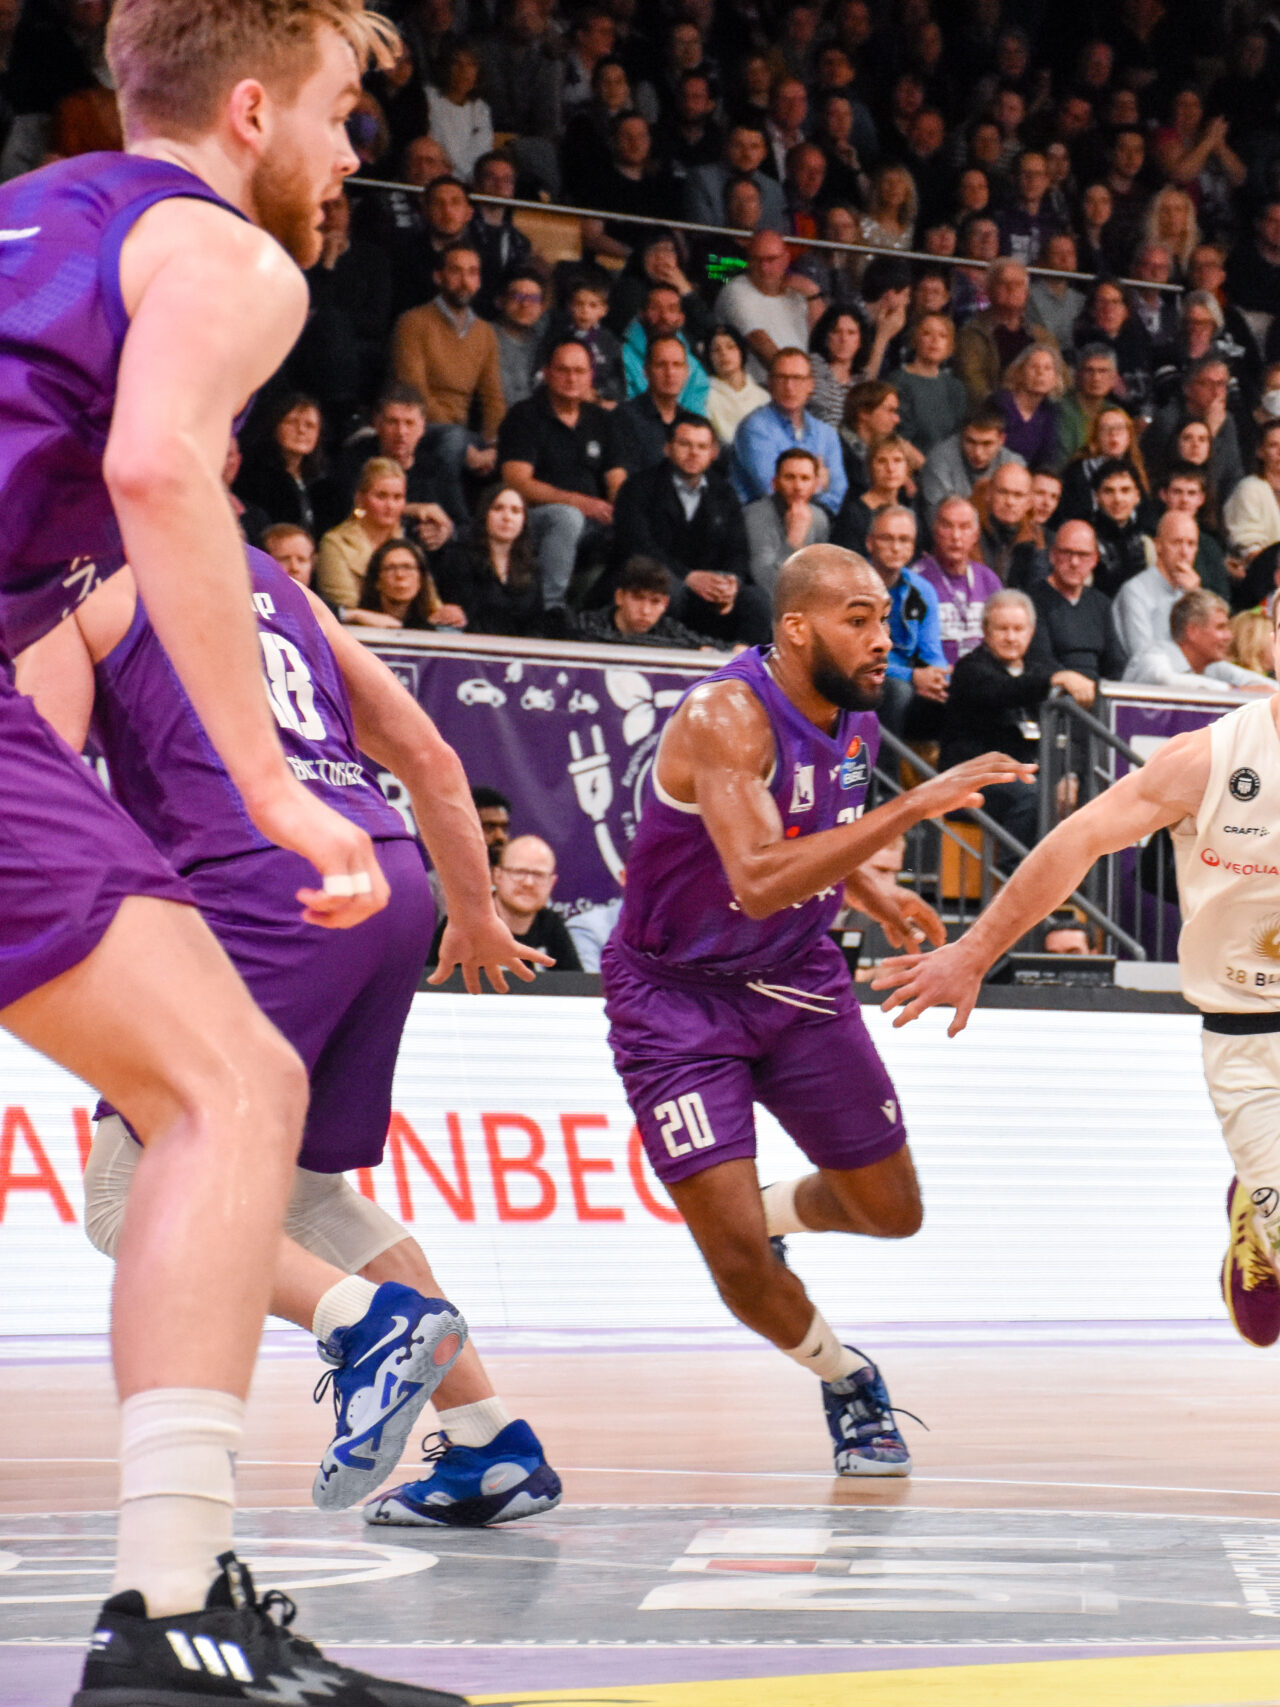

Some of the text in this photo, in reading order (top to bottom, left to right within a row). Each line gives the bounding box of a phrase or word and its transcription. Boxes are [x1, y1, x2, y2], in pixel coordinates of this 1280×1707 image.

[258, 631, 328, 741] 8
[1223, 825, 1260, 837] CRAFT
[1221, 858, 1280, 876] VEOLIA
[1225, 966, 1248, 984] 28
[653, 1091, 716, 1159] 20
[501, 1638, 798, 1646] PARTNER
